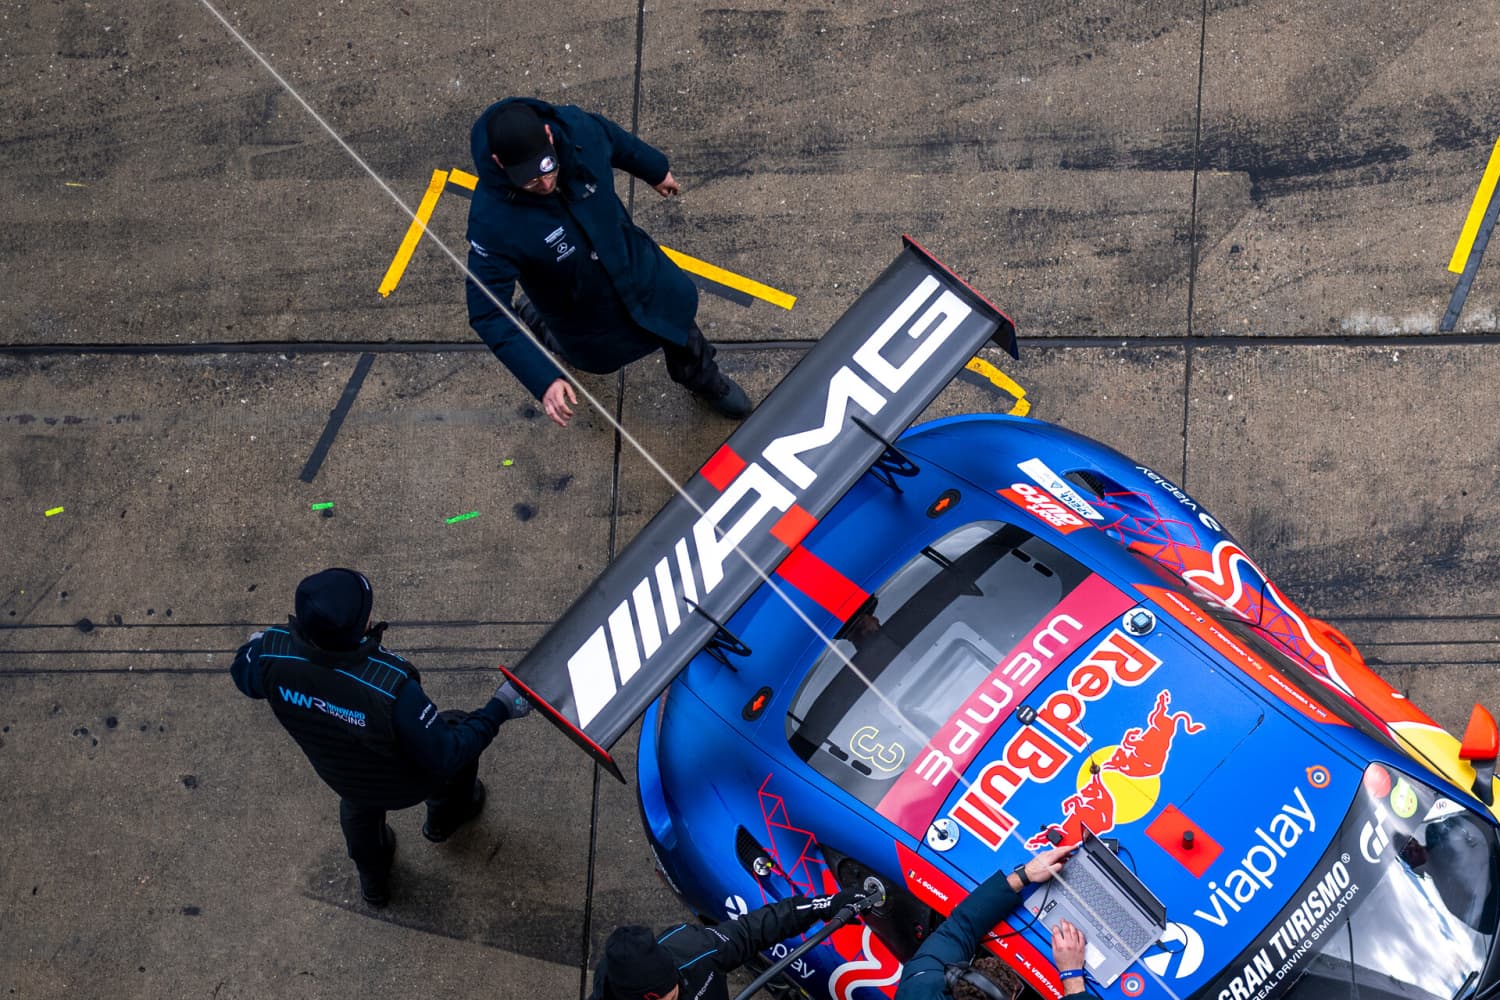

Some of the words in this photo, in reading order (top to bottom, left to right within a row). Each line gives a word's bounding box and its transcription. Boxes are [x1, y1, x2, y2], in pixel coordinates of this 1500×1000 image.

[695, 274, 972, 595] AMG
[849, 725, 906, 772] 3
[915, 613, 1083, 786] WEMPE
[1194, 787, 1316, 928] viaplay
[1275, 938, 1313, 983] DRIVING
[1310, 884, 1360, 943] SIMULATOR
